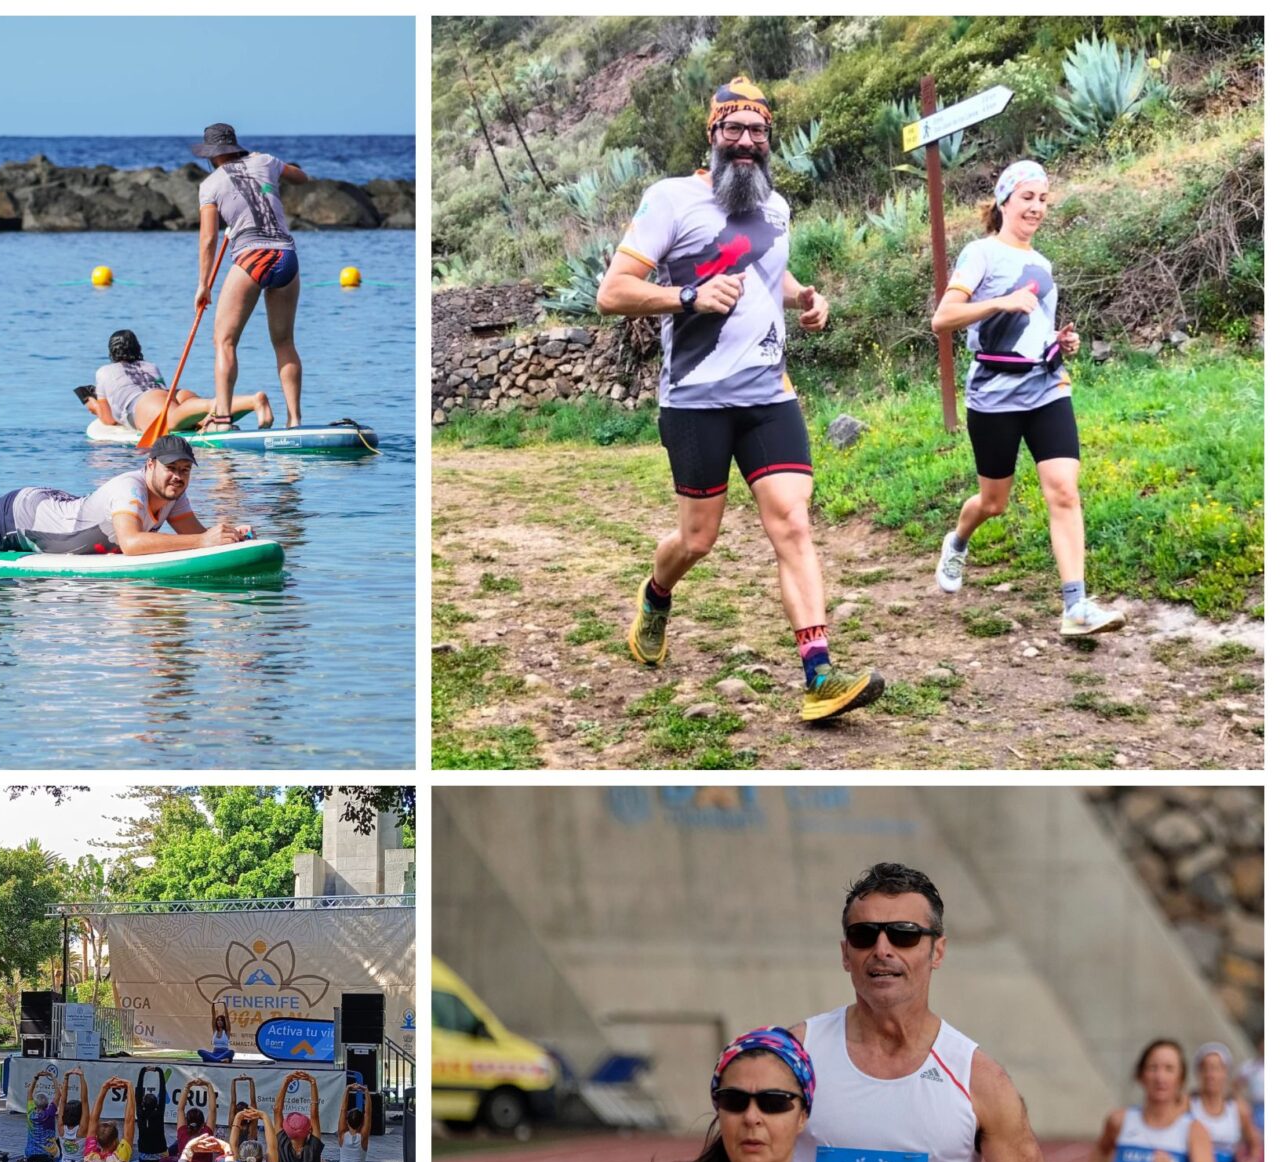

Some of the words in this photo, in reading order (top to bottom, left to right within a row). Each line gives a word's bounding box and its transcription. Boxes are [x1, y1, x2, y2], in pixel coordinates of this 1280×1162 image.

[120, 996, 152, 1010] OGA
[223, 995, 300, 1009] TENERIFE
[228, 1010, 265, 1028] OGA
[268, 1024, 303, 1037] Activa
[306, 1027, 318, 1037] tu
